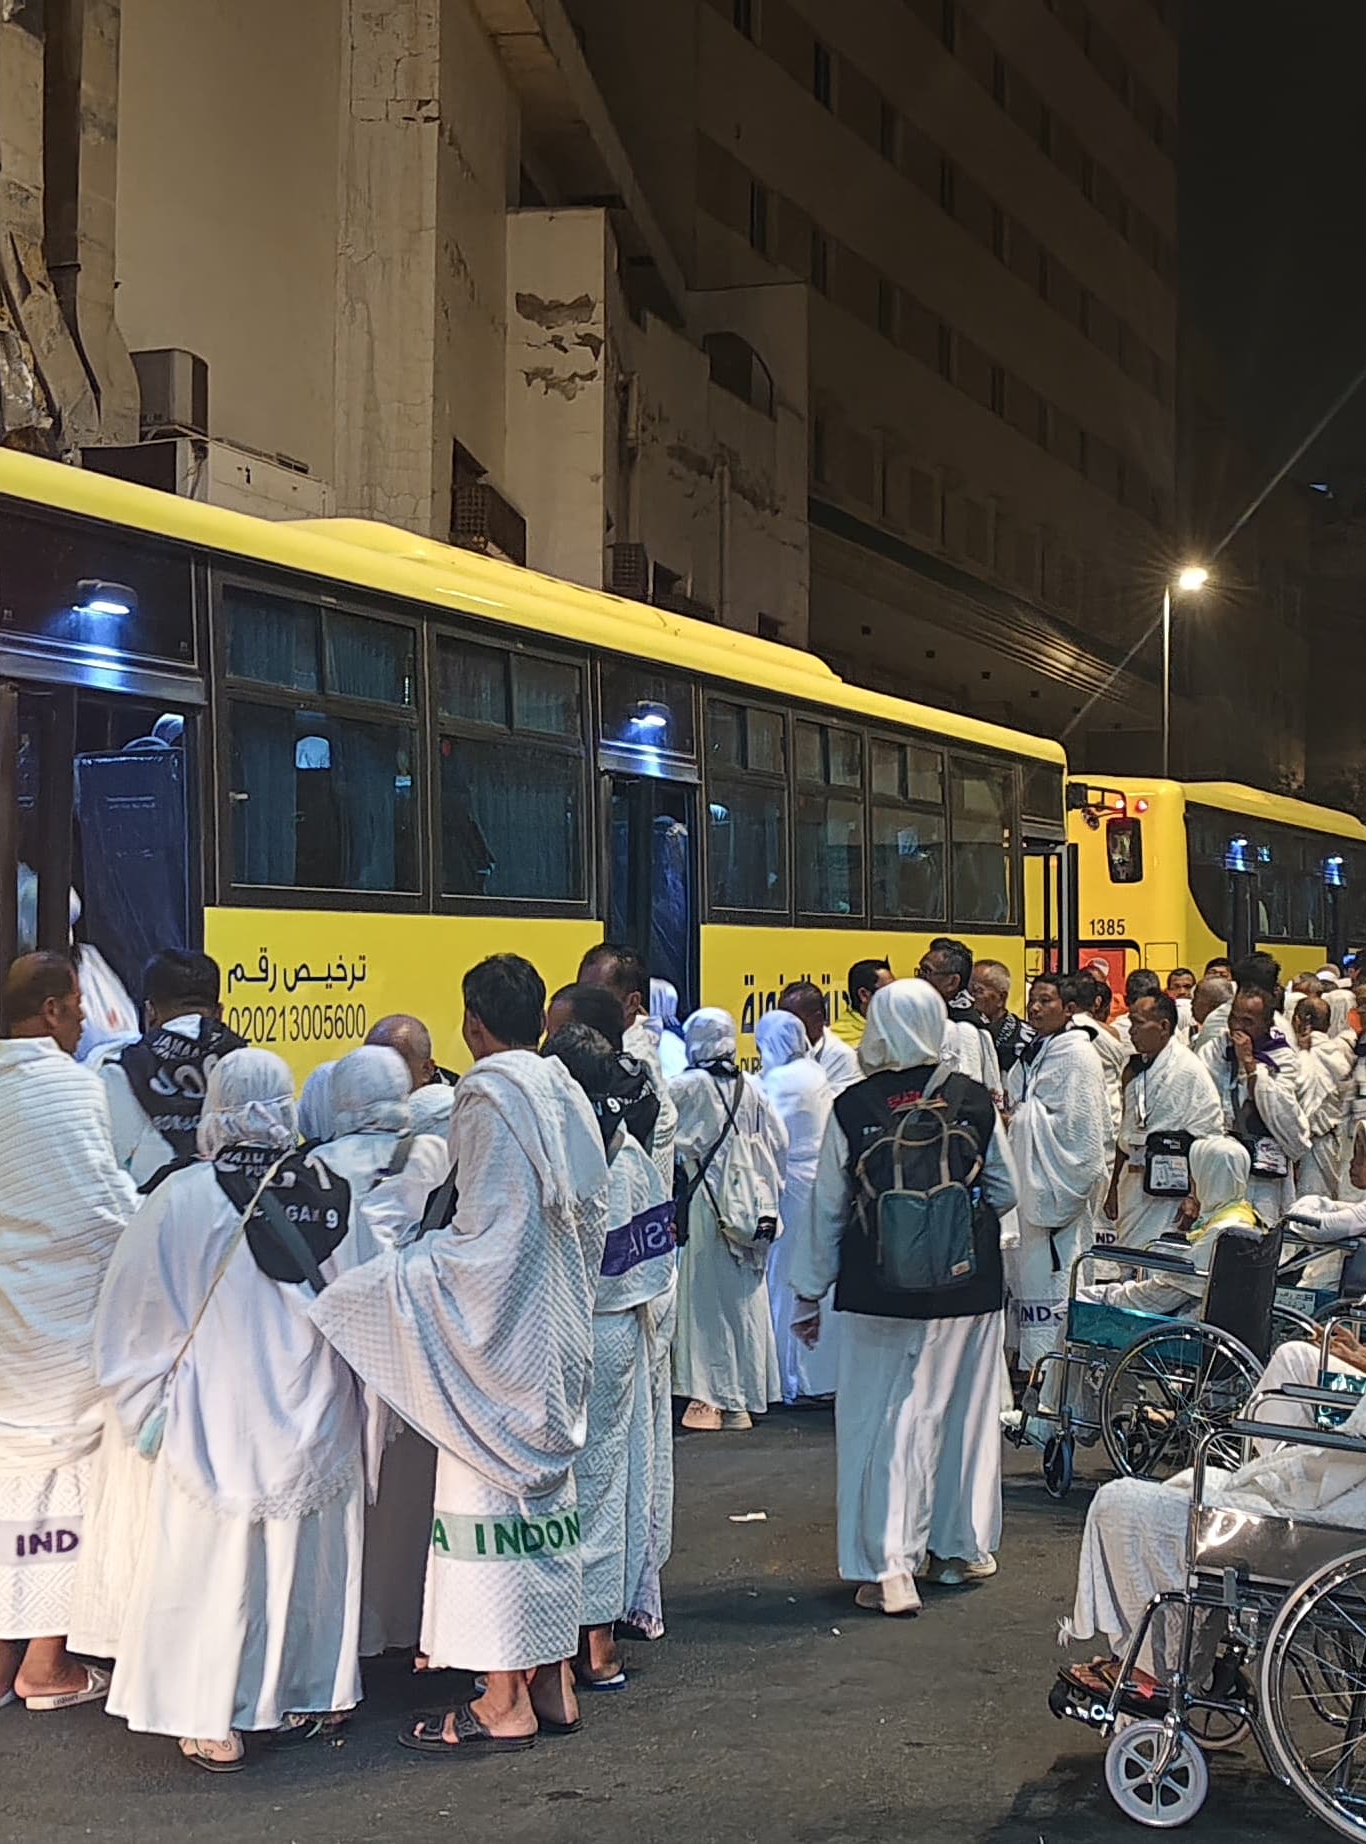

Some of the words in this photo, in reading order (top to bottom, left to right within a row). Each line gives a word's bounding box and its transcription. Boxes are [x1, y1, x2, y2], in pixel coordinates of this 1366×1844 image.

[1089, 918, 1126, 936] 1385
[227, 946, 277, 994] رقم
[283, 955, 366, 993] ترخيص
[229, 1003, 366, 1043] 020213005600
[325, 1208, 339, 1229] 9
